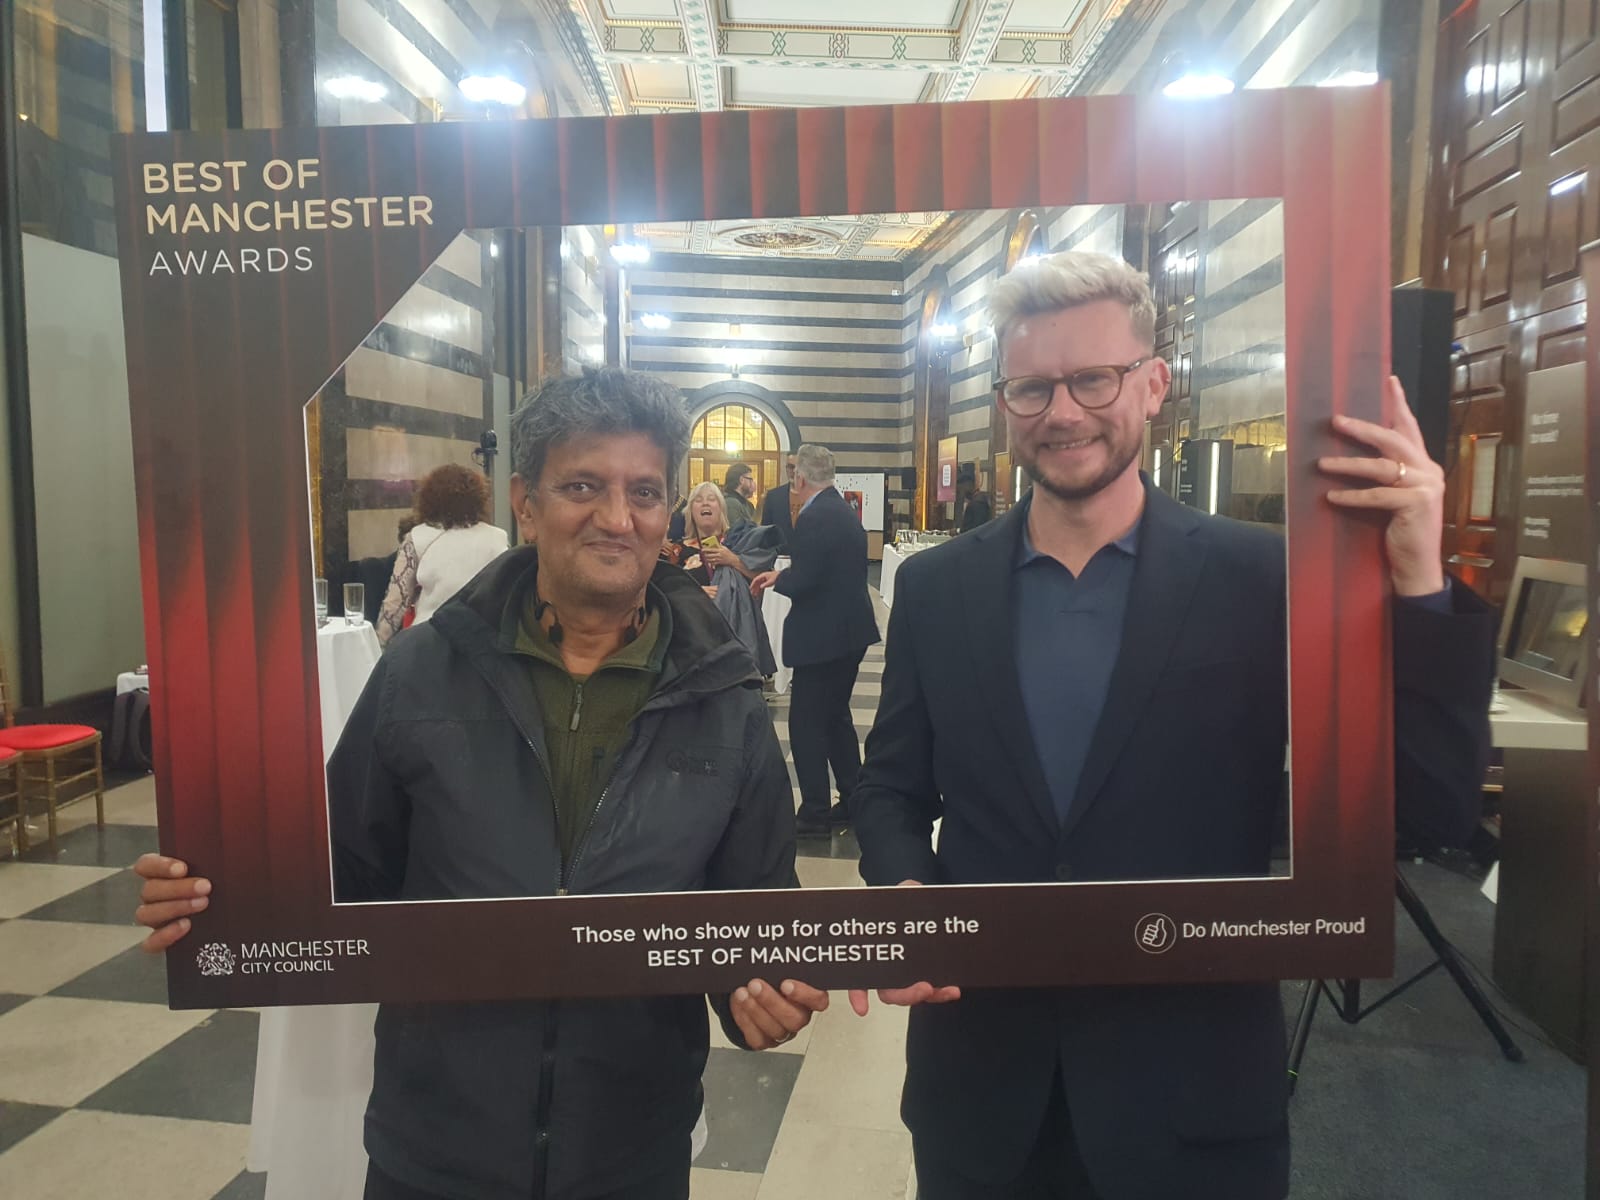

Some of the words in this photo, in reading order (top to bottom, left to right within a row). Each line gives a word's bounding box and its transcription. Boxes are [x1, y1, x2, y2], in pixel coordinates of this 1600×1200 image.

[143, 160, 247, 194] BEST
[262, 158, 320, 191] OF
[146, 195, 434, 235] MANCHESTER
[150, 246, 314, 276] AWARDS
[572, 925, 636, 942] Those
[643, 923, 688, 940] who
[695, 921, 750, 939] show
[757, 923, 785, 941] up
[792, 919, 821, 936] for
[828, 918, 897, 935] others
[903, 919, 937, 934] are
[943, 916, 979, 932] the
[1183, 922, 1205, 938] Do
[1210, 920, 1312, 936] Manchester
[1315, 917, 1366, 933] Proud
[241, 939, 371, 958] MANCHESTER
[647, 948, 703, 966] BEST
[711, 947, 743, 964] OF
[750, 944, 905, 963] MANCHESTER
[241, 962, 271, 973] CITY
[274, 960, 335, 972] COUNCIL
